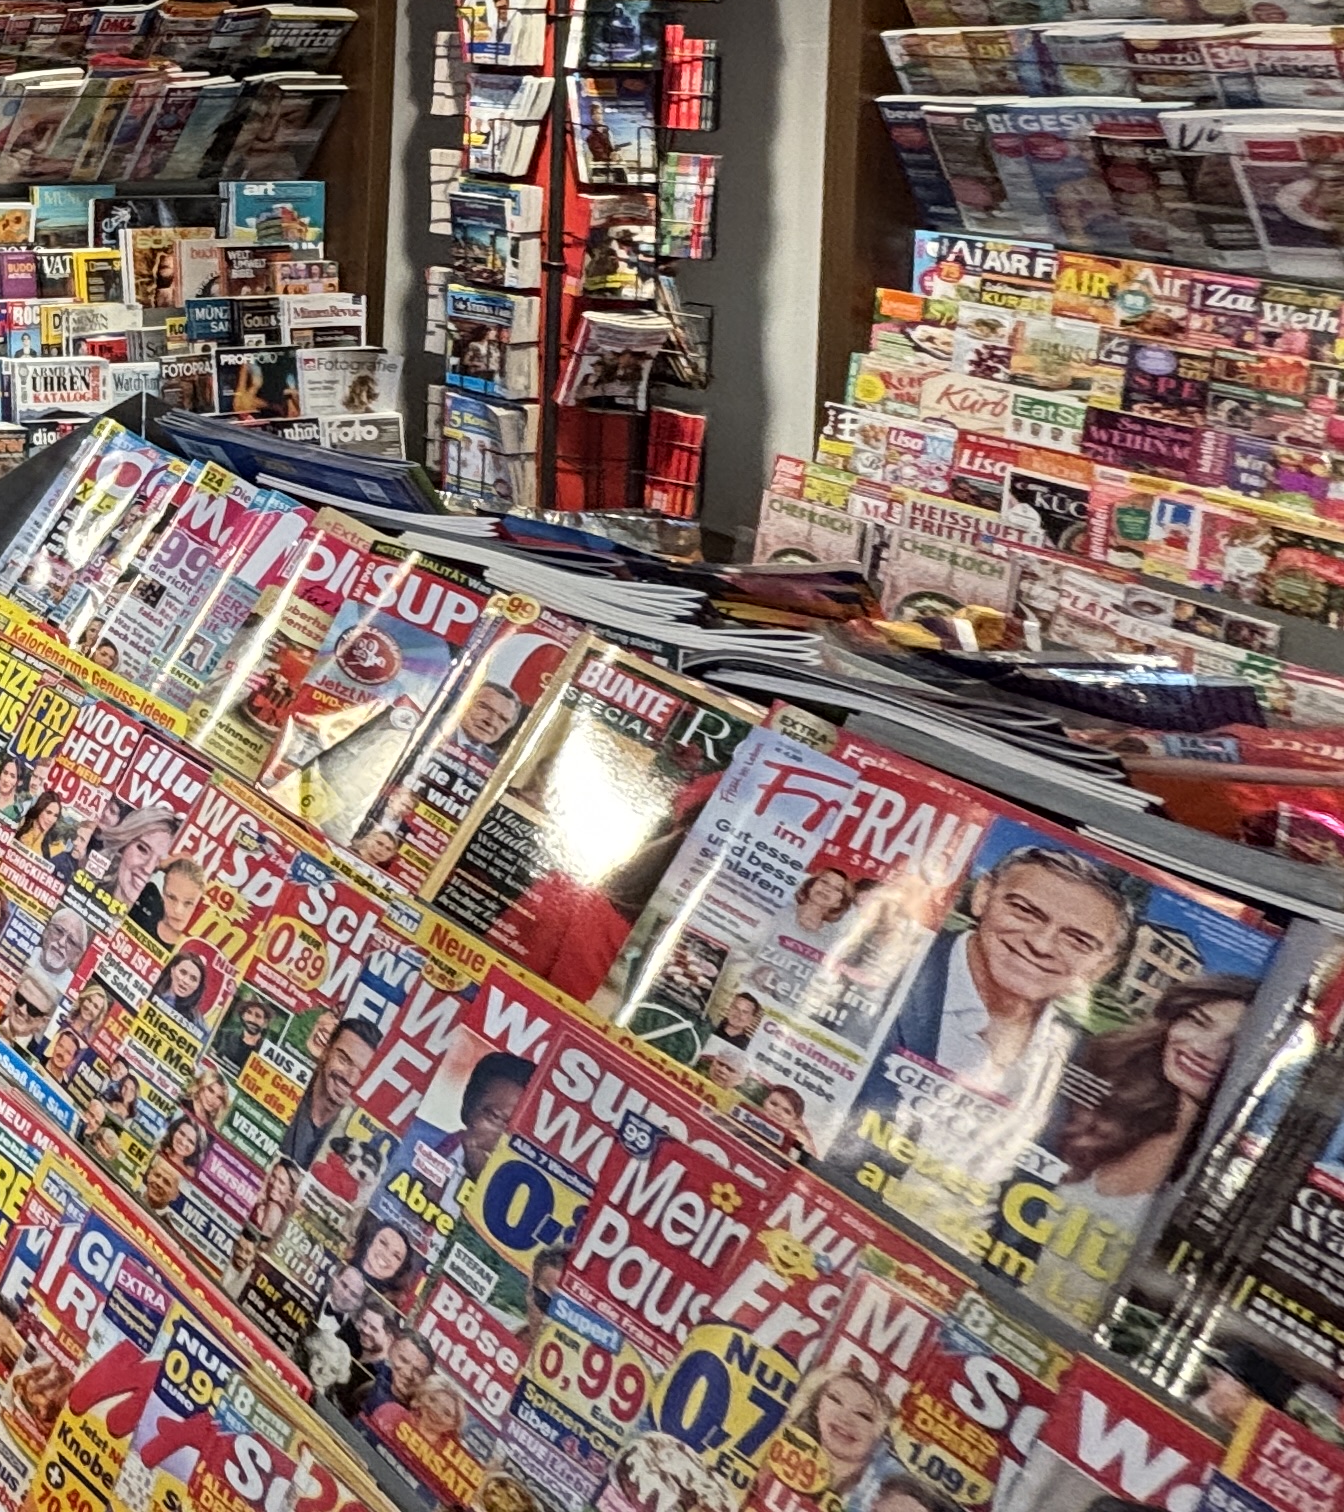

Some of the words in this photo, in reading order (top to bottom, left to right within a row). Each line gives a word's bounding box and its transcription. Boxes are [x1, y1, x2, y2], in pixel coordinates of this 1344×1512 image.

[243, 182, 275, 196] art
[1060, 268, 1111, 299] AIR
[31, 366, 92, 377] ARMBAND
[31, 376, 90, 392] UHREN
[32, 391, 93, 403] KATALOG
[888, 429, 925, 450] Lisa
[958, 449, 1012, 477] Lisa
[768, 497, 855, 536] CHEFKOCH
[910, 500, 1027, 544] HEISSLUFT
[898, 536, 1005, 579] CHEFKOCH
[11, 624, 89, 679] Kalorienarme
[91, 672, 176, 729] Genuss-Ideen
[579, 661, 674, 722] BUNTE
[780, 715, 834, 744] EXTRA-
[774, 822, 806, 848] im
[837, 780, 985, 880] FRAU
[265, 926, 326, 982] 0,89
[426, 922, 488, 973] Neue
[453, 1244, 496, 1284] STEFAN
[117, 1268, 169, 1310] EXTRA
[430, 1288, 520, 1376] Böse
[552, 1300, 621, 1349] Super!
[161, 1377, 196, 1411] EURO
[536, 1336, 646, 1423] 0,99
[588, 1405, 626, 1438] Euro
